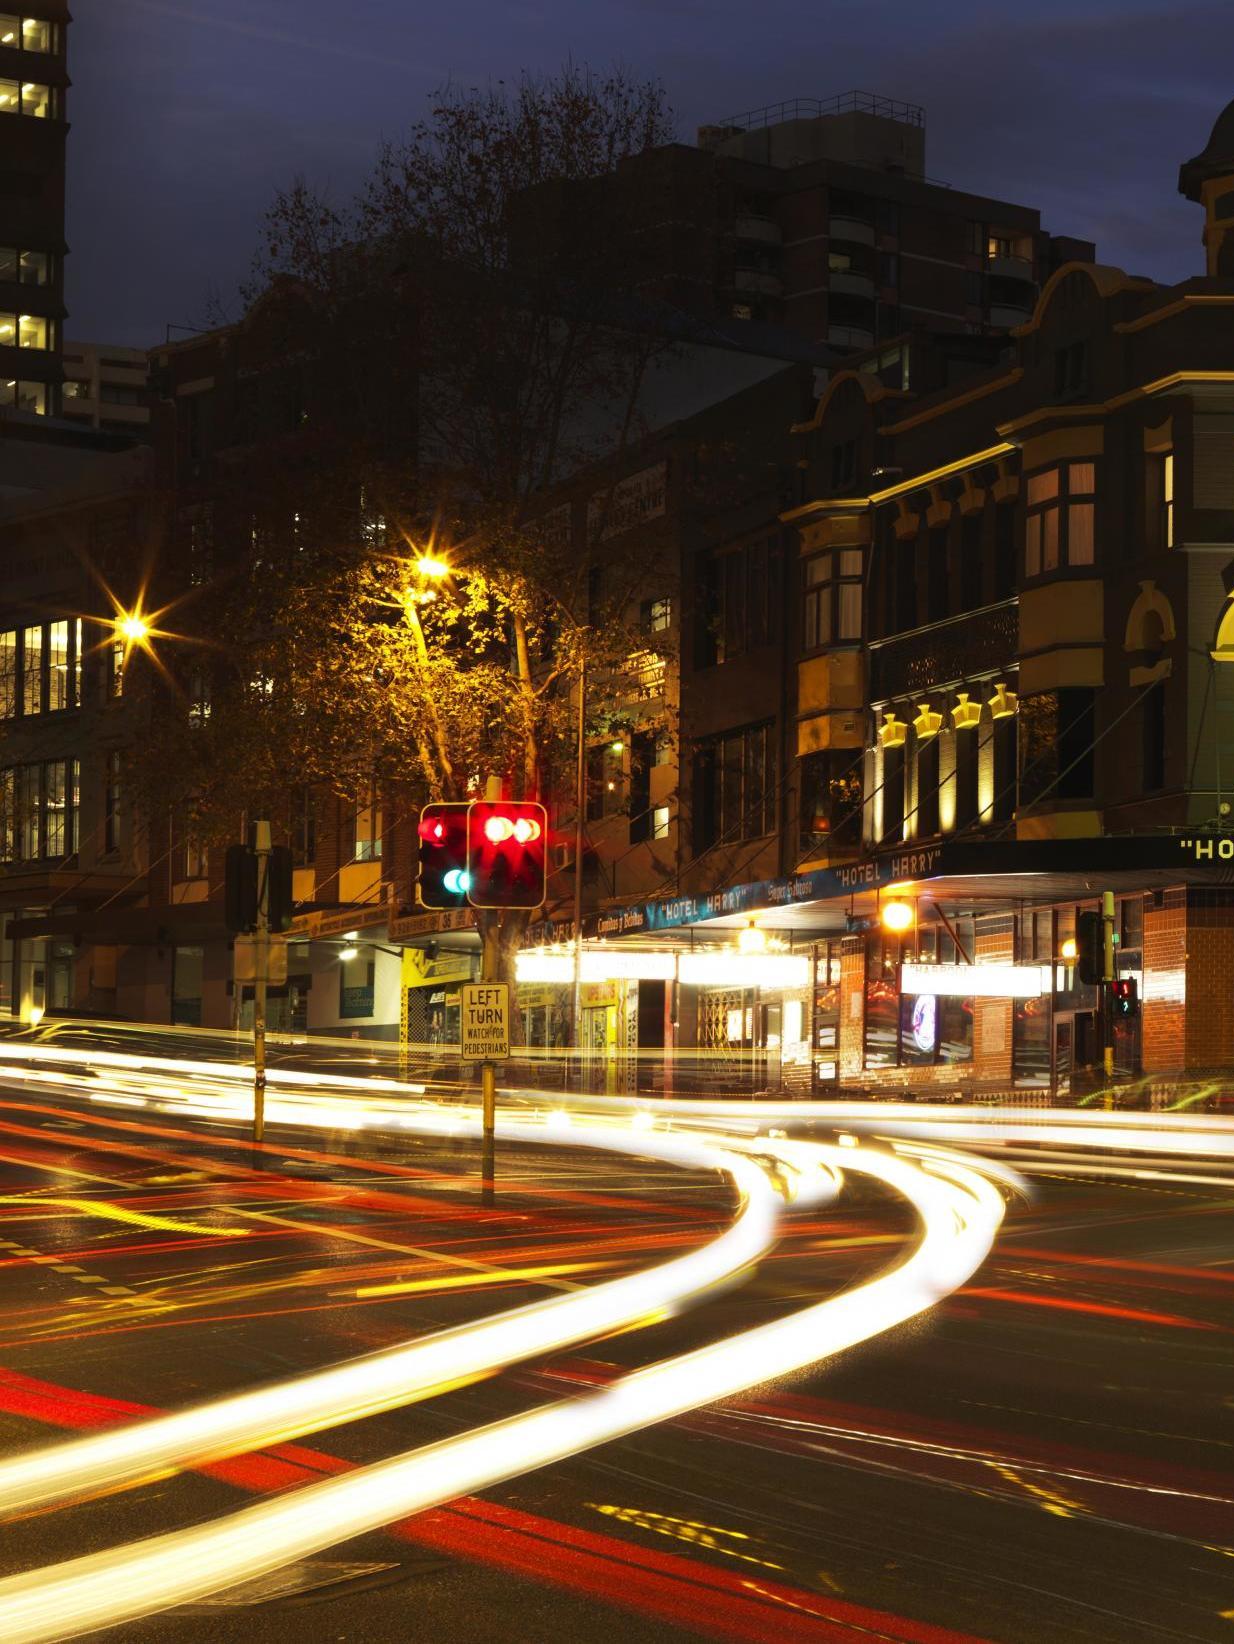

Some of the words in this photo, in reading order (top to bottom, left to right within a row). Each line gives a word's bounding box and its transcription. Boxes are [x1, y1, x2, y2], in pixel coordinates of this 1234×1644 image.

[836, 862, 880, 887] "HOTEL
[891, 850, 941, 878] HARRY"
[469, 989, 501, 1005] LEFT
[468, 1008, 503, 1024] TURN
[467, 1028, 490, 1039] WATCH
[493, 1027, 504, 1039] FOR
[464, 1042, 507, 1055] PEDESTRIANS
